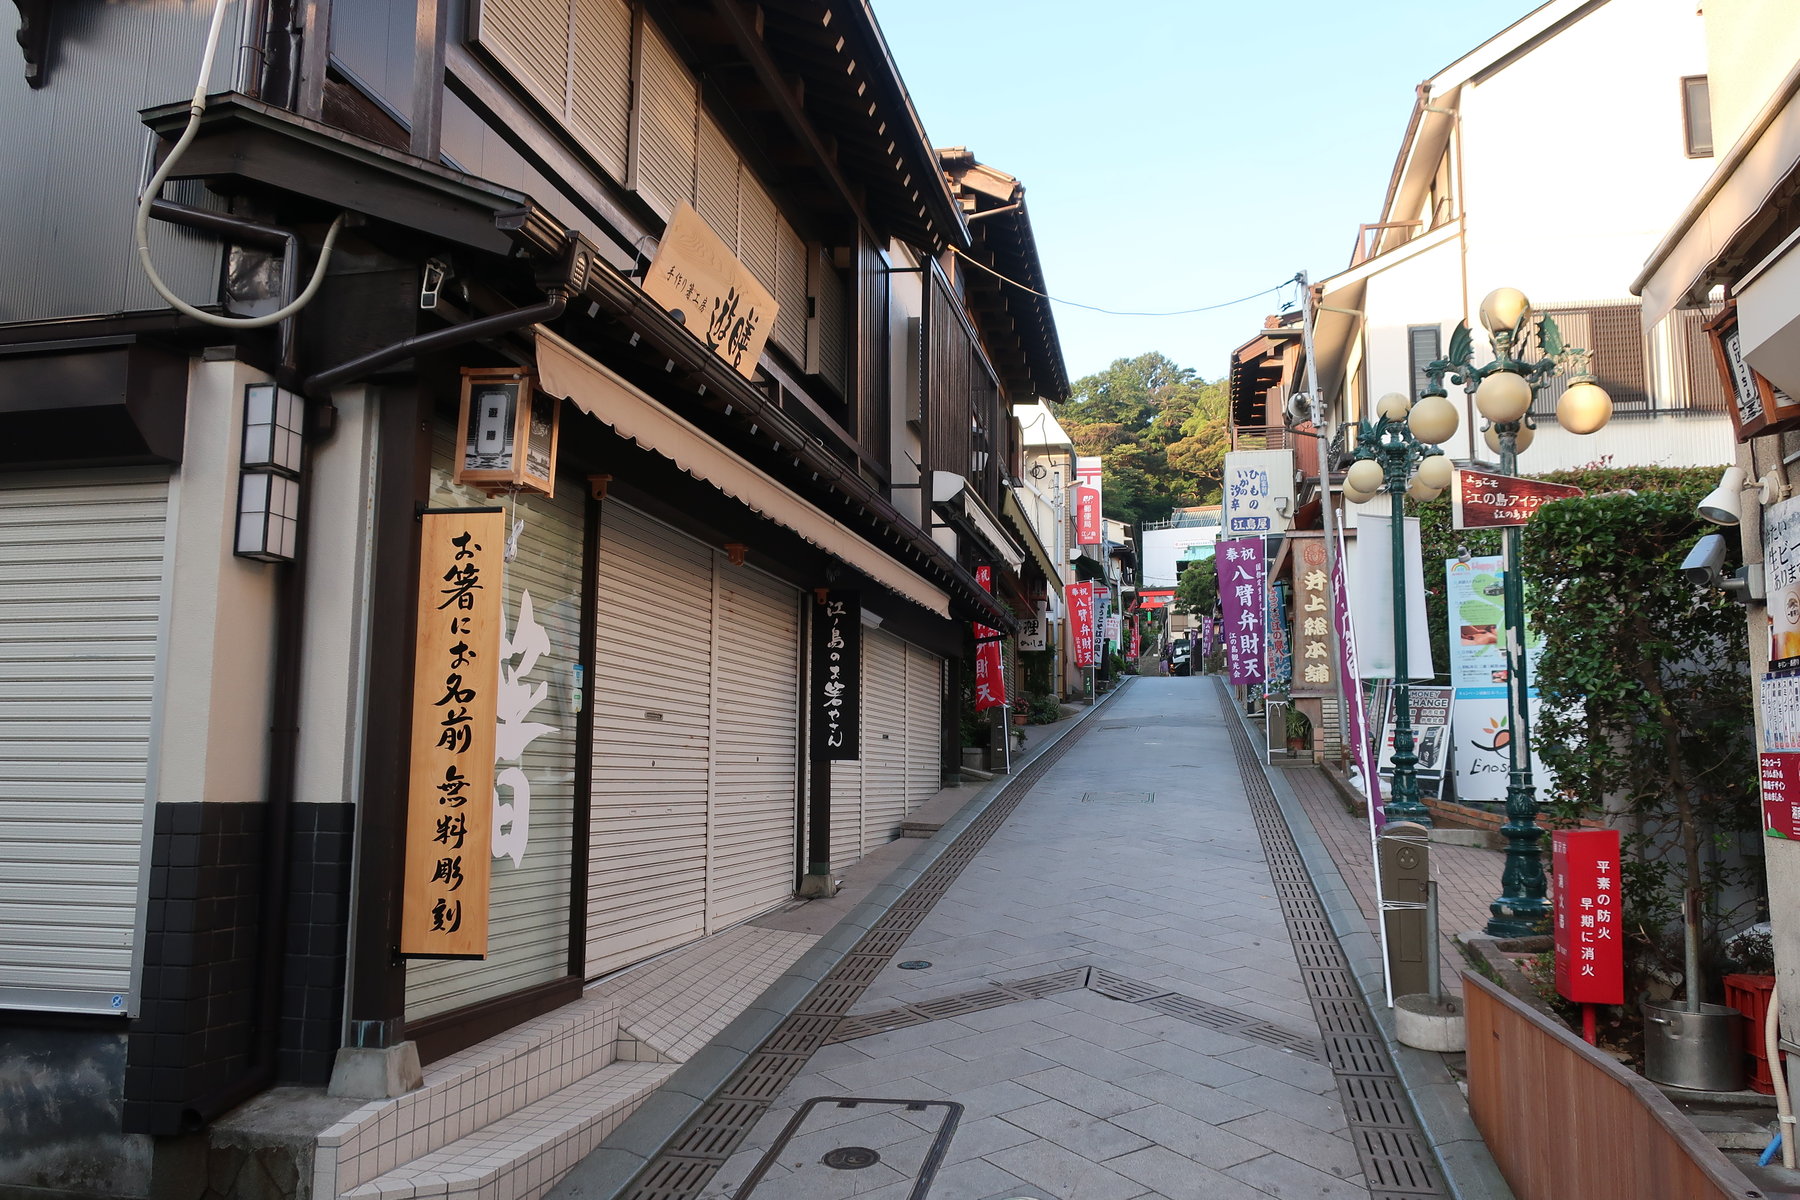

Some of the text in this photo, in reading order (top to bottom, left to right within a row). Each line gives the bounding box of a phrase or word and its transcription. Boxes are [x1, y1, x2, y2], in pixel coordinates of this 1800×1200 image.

[667, 265, 708, 313] 手作り箸工房
[1249, 470, 1259, 510] ひもの
[1466, 475, 1499, 488] ようこそ
[1466, 490, 1558, 507] 江の島アイラン
[1083, 505, 1092, 529] 郵便局
[1233, 518, 1268, 530] 江島屋
[1225, 547, 1257, 563] 奉祝
[1774, 563, 1800, 591] ありま
[1232, 565, 1261, 678] 八臂弁財天
[1304, 569, 1330, 684] 井上総本舗
[429, 531, 484, 935] お箸にお名前無料彫刻
[1596, 860, 1611, 940] 平素の防火
[1580, 898, 1595, 977] 早期に消火
